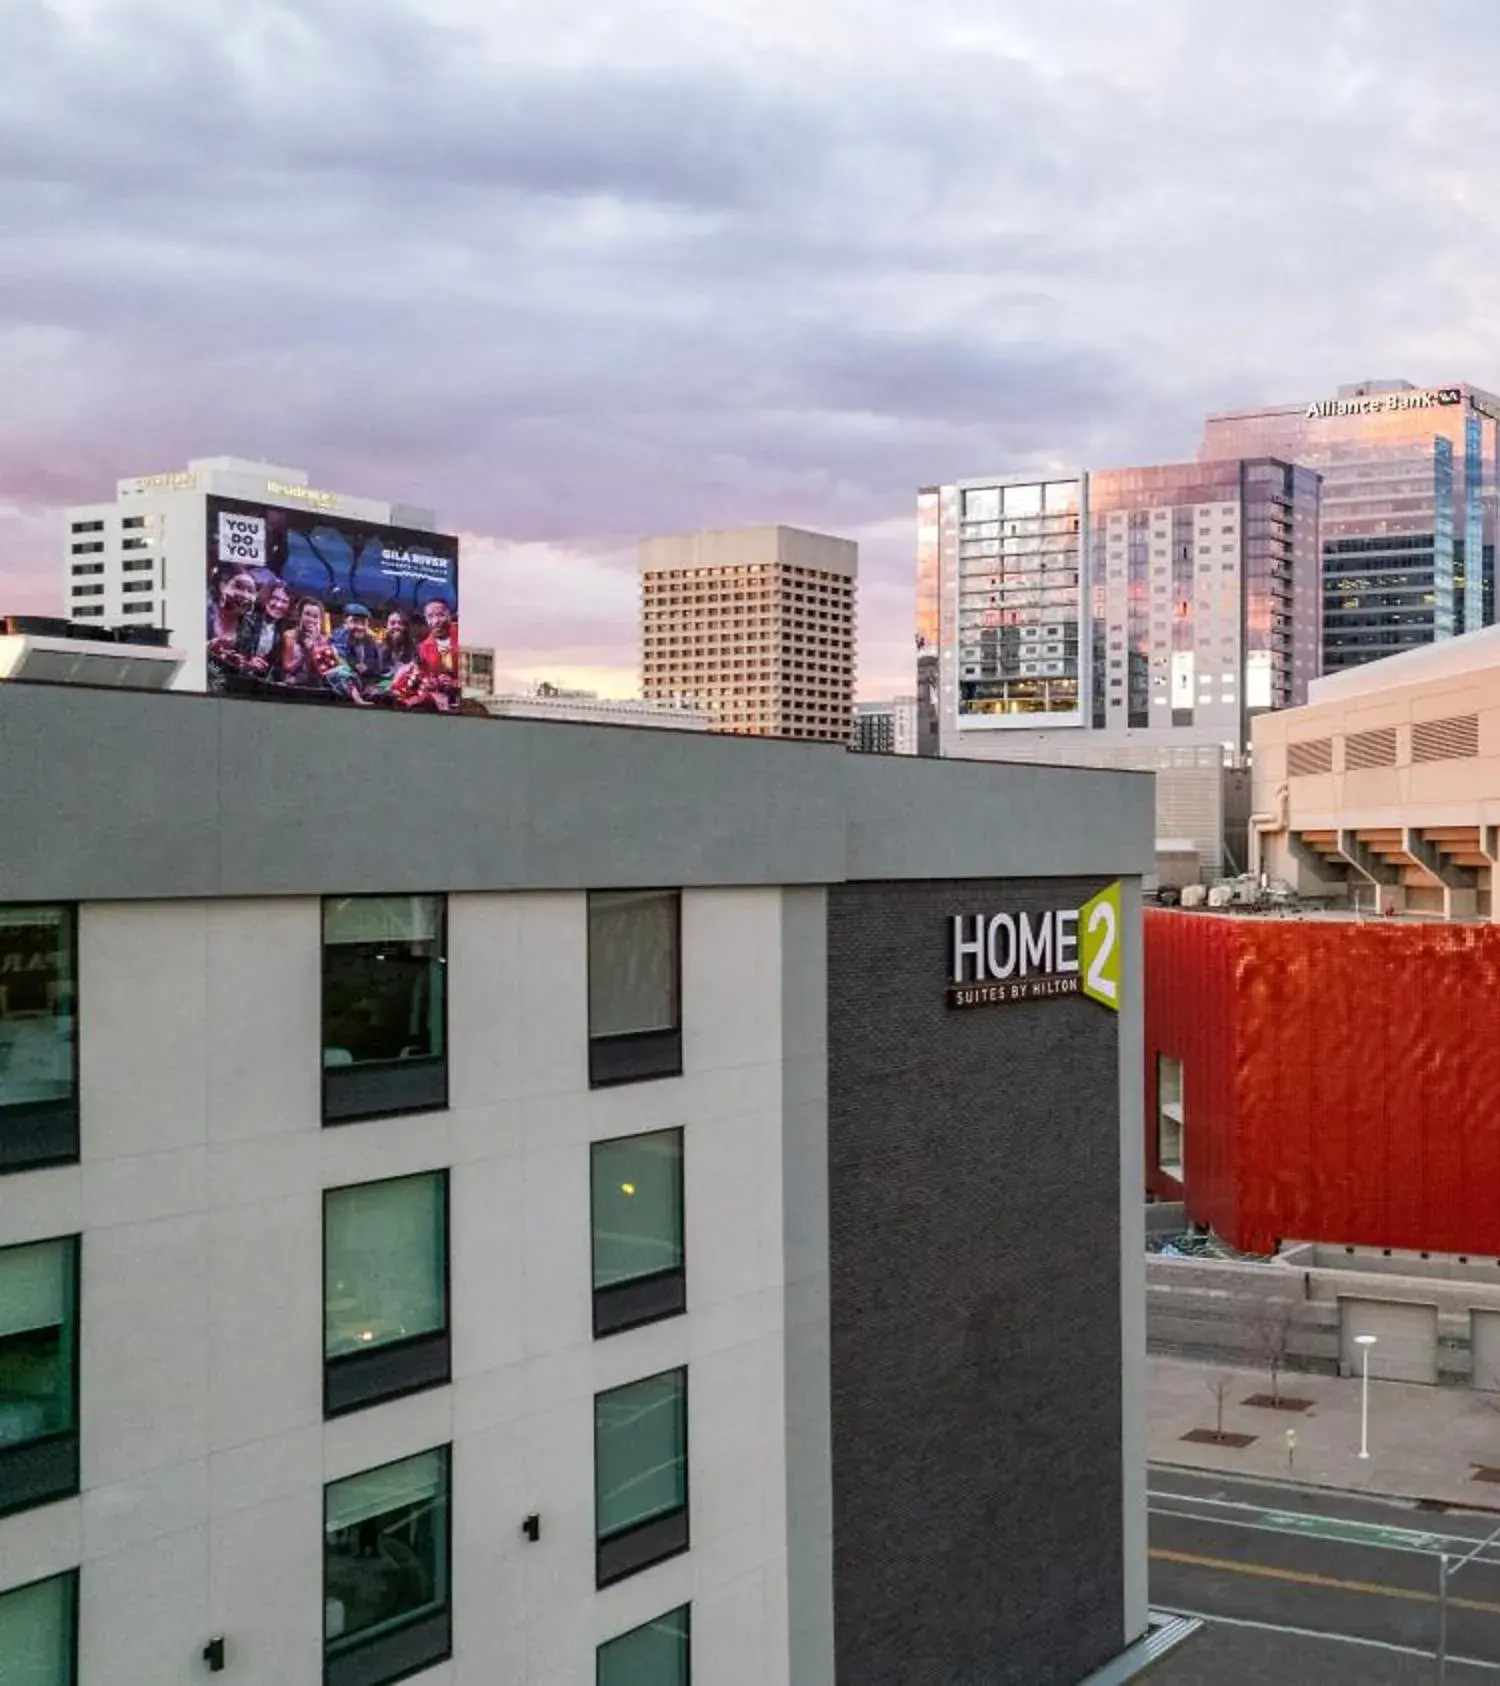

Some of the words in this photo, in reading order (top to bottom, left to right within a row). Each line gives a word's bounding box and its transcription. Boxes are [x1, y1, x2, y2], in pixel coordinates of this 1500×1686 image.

[1306, 398, 1380, 419] Alliance
[1387, 390, 1437, 411] Bank
[226, 518, 259, 534] YOU
[231, 532, 253, 545] DO
[226, 543, 259, 559] YOU
[381, 549, 411, 562] GILA
[953, 909, 1079, 982] HOME
[1087, 901, 1116, 998] 2
[956, 985, 1006, 1005] SUITES
[1011, 983, 1027, 999] BY
[1032, 978, 1077, 996] HILTON
